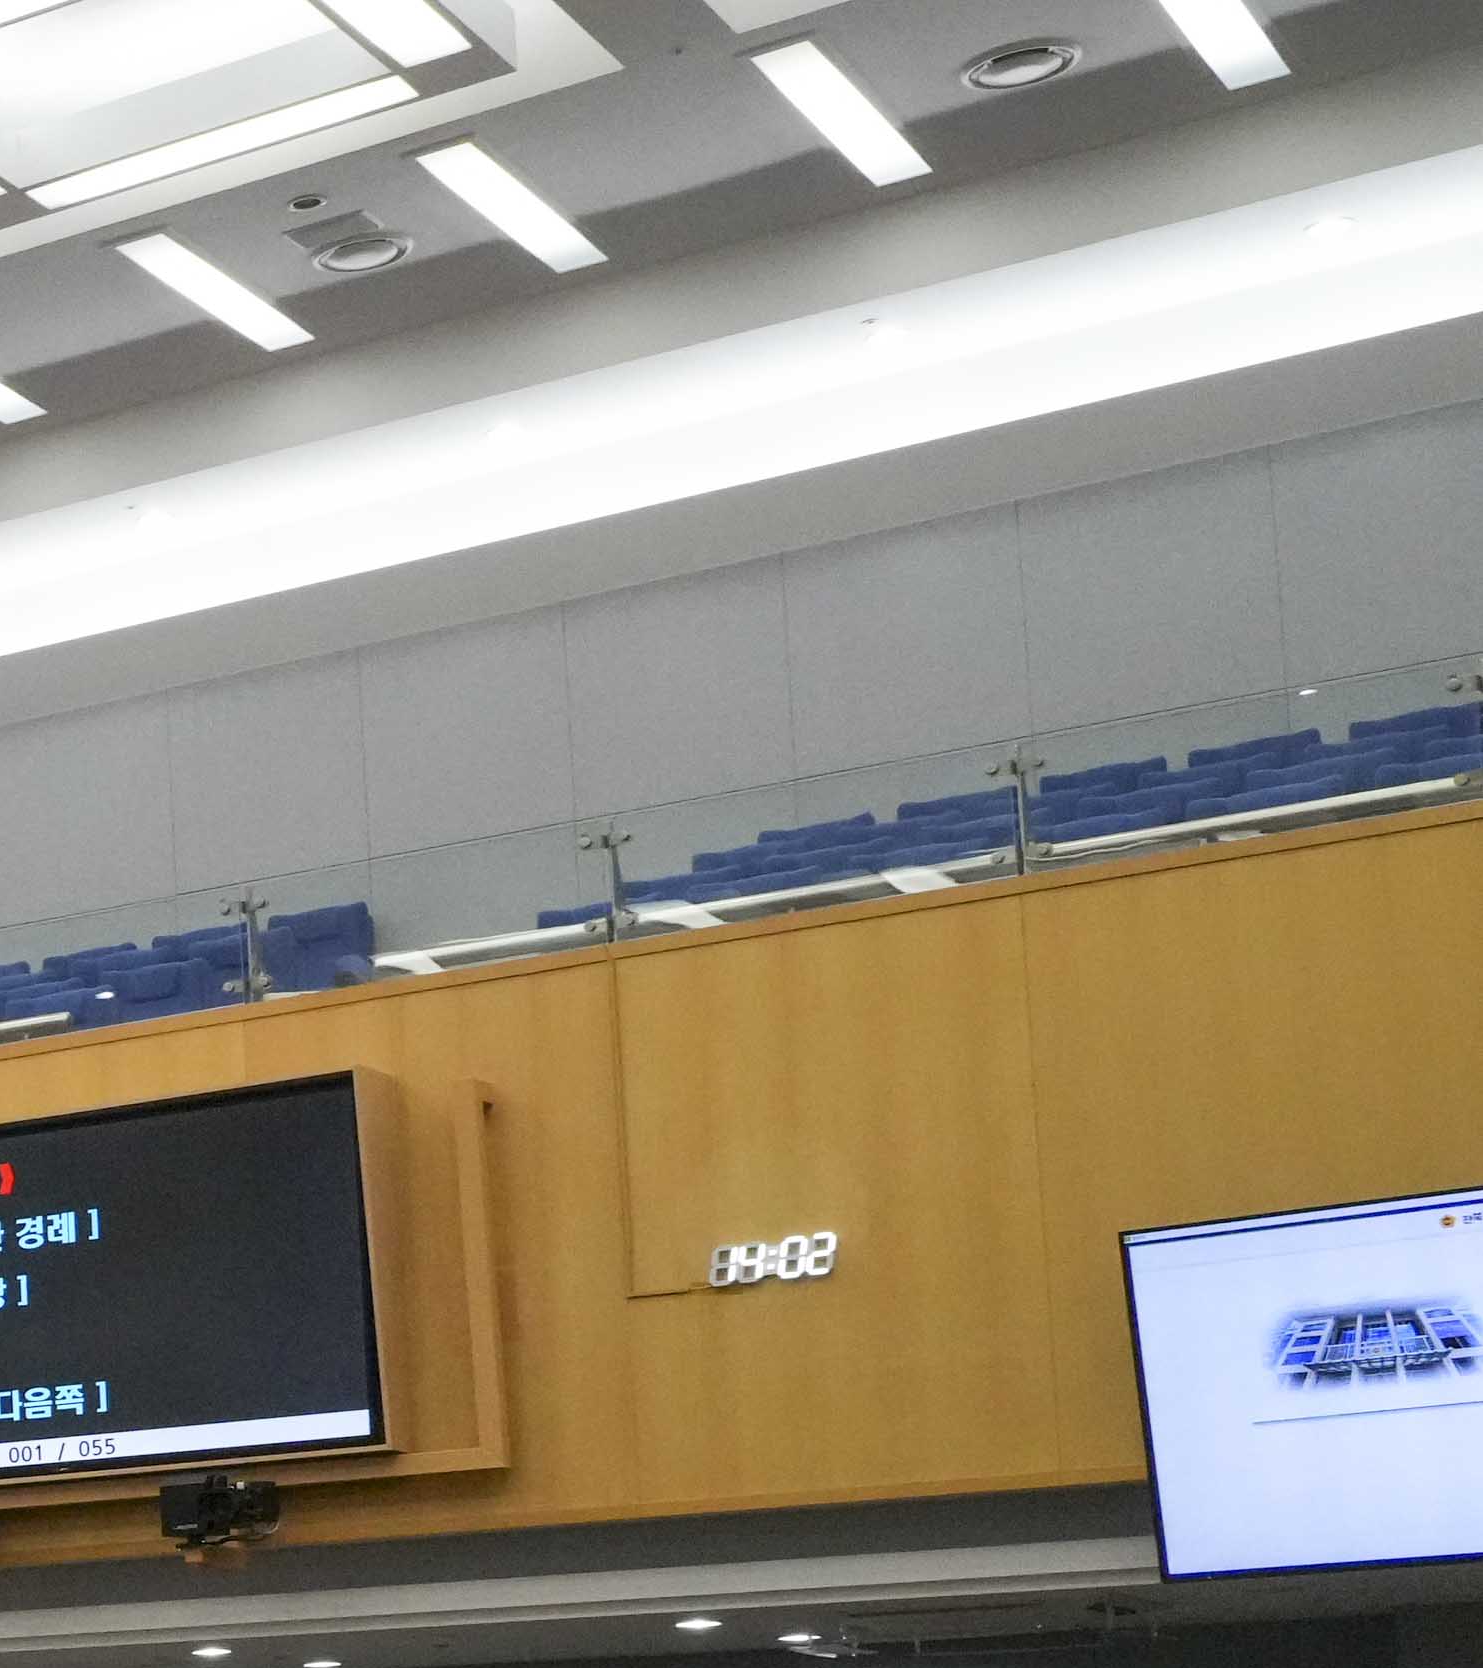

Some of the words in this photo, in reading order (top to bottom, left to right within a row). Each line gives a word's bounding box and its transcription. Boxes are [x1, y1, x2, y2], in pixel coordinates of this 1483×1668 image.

[15, 1210, 77, 1250] 경례
[725, 1231, 838, 1283] 14:02
[8, 1444, 43, 1464] 001
[78, 1438, 116, 1457] 055
